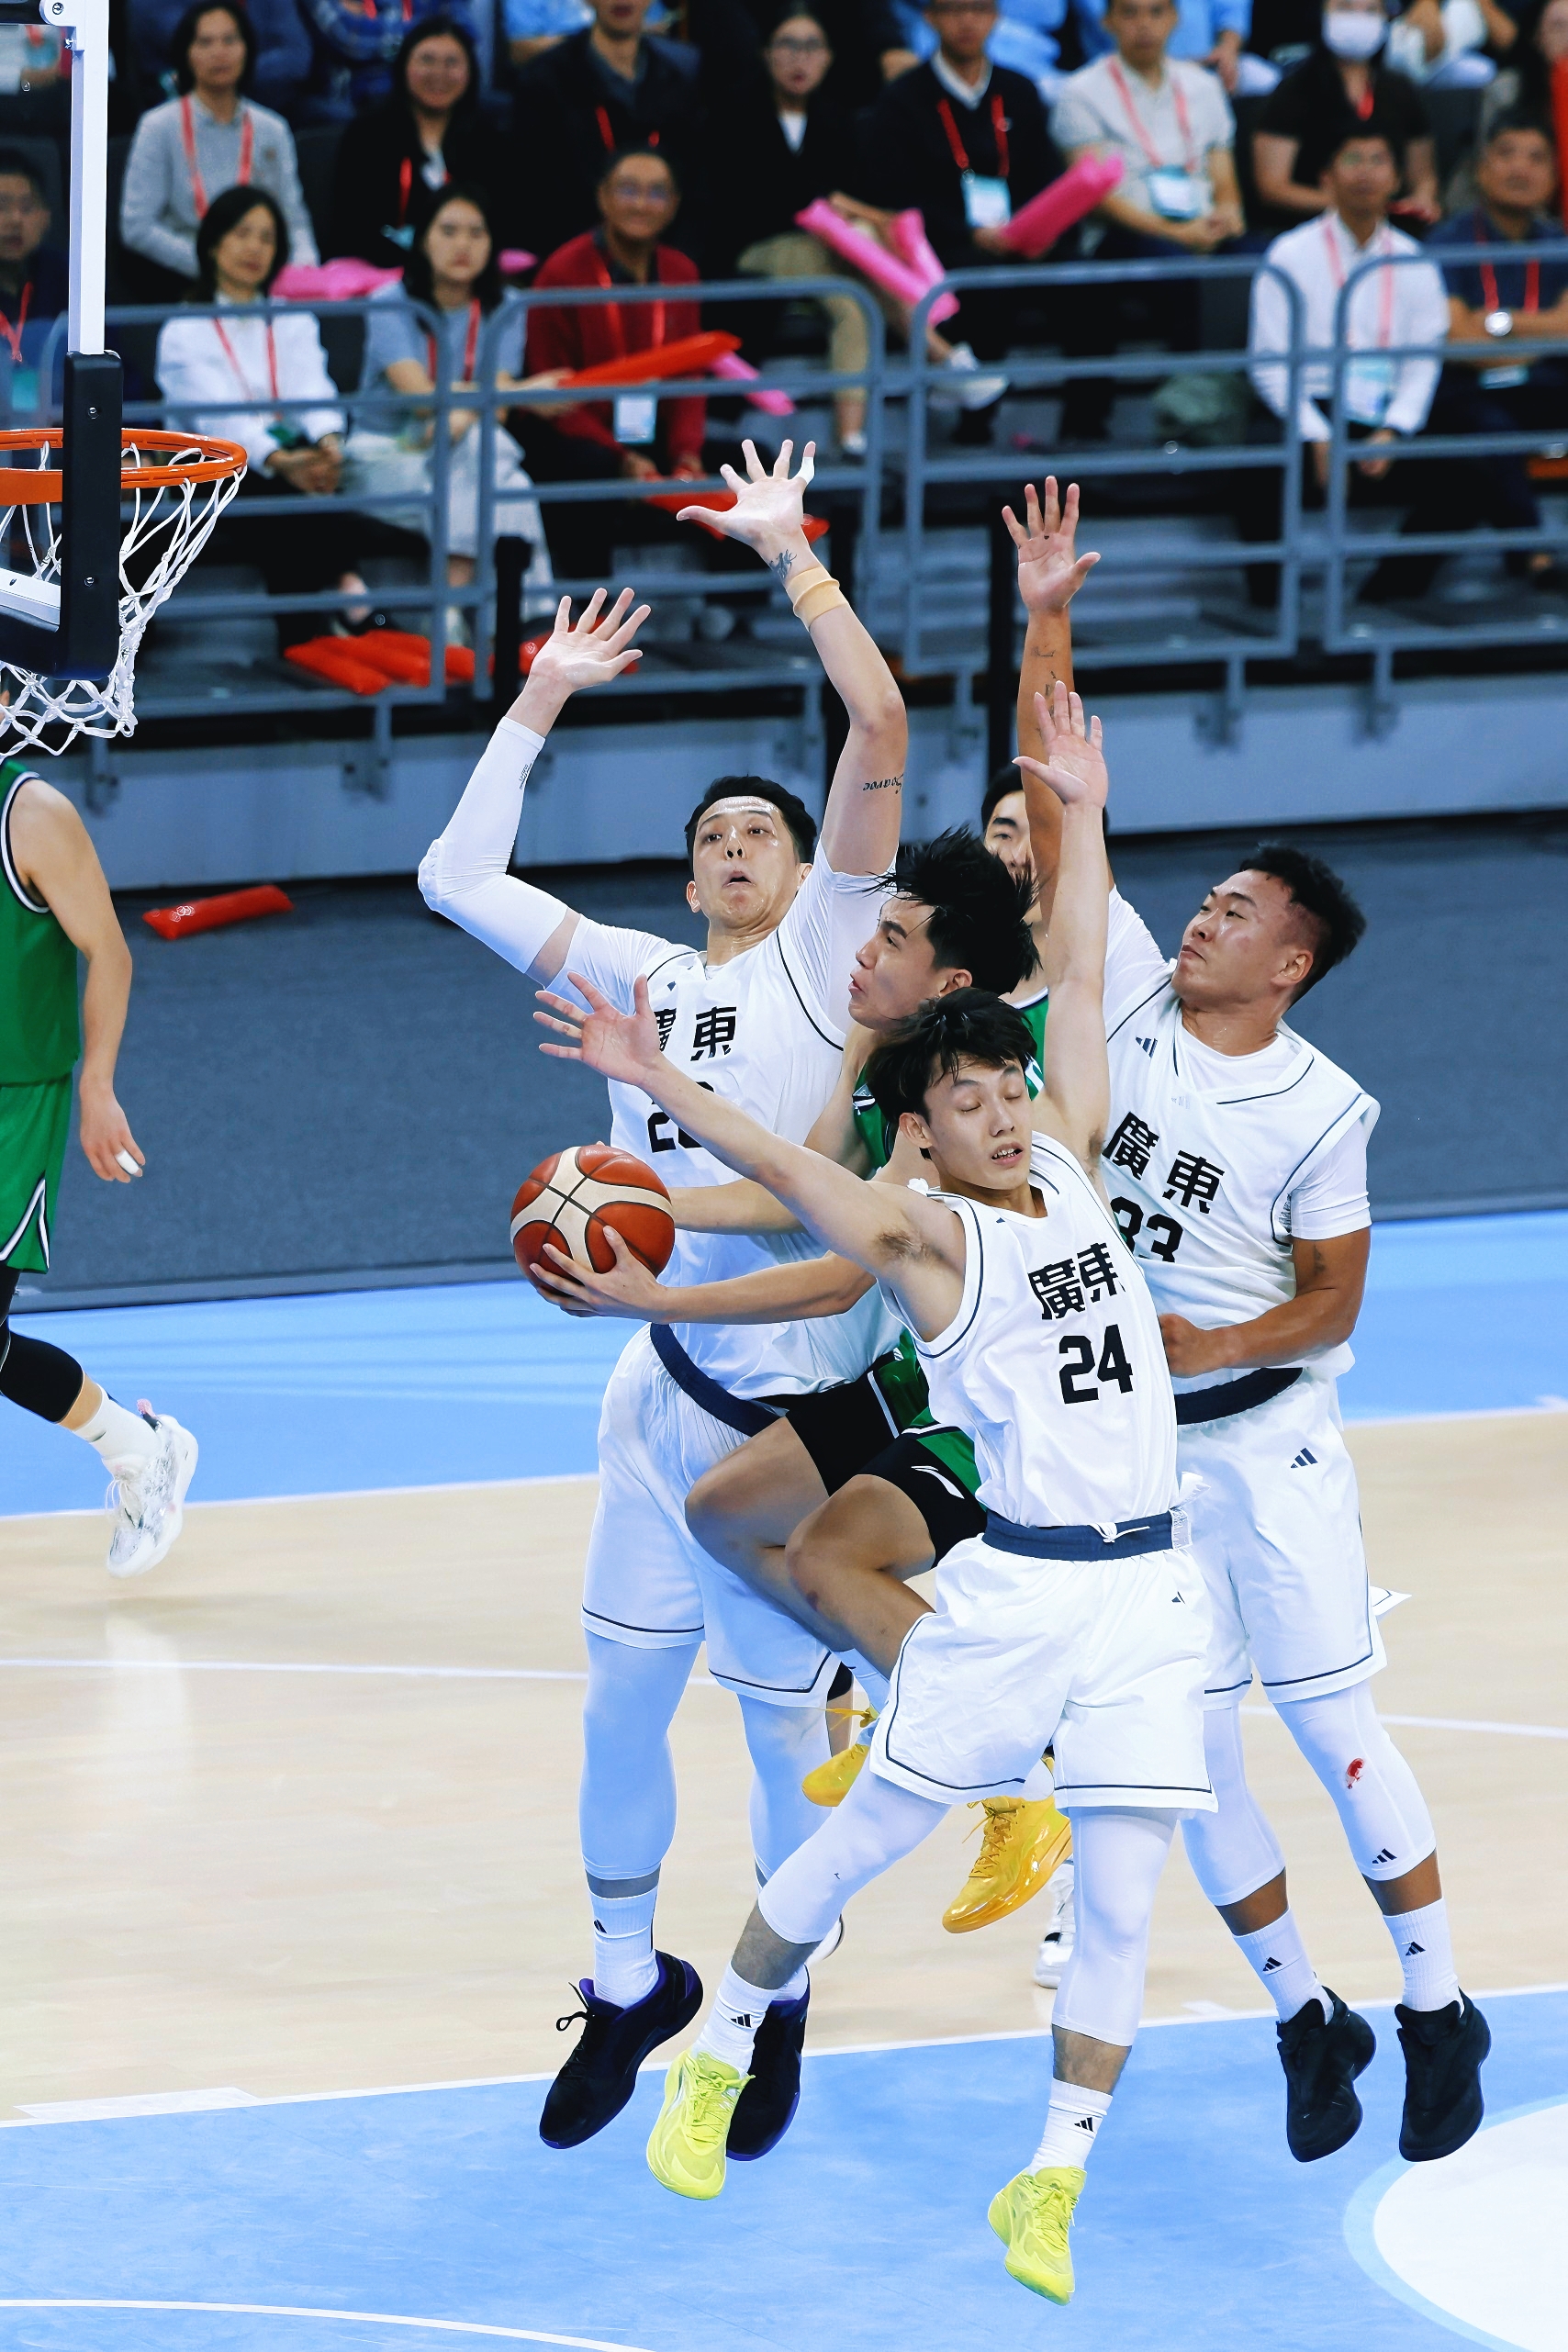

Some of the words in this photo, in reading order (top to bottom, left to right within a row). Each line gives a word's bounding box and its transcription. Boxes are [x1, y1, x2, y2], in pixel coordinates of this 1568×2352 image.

[1103, 1112, 1226, 1215] 廣東
[1027, 1242, 1126, 1320] 廣東
[1058, 1324, 1134, 1405] 24
